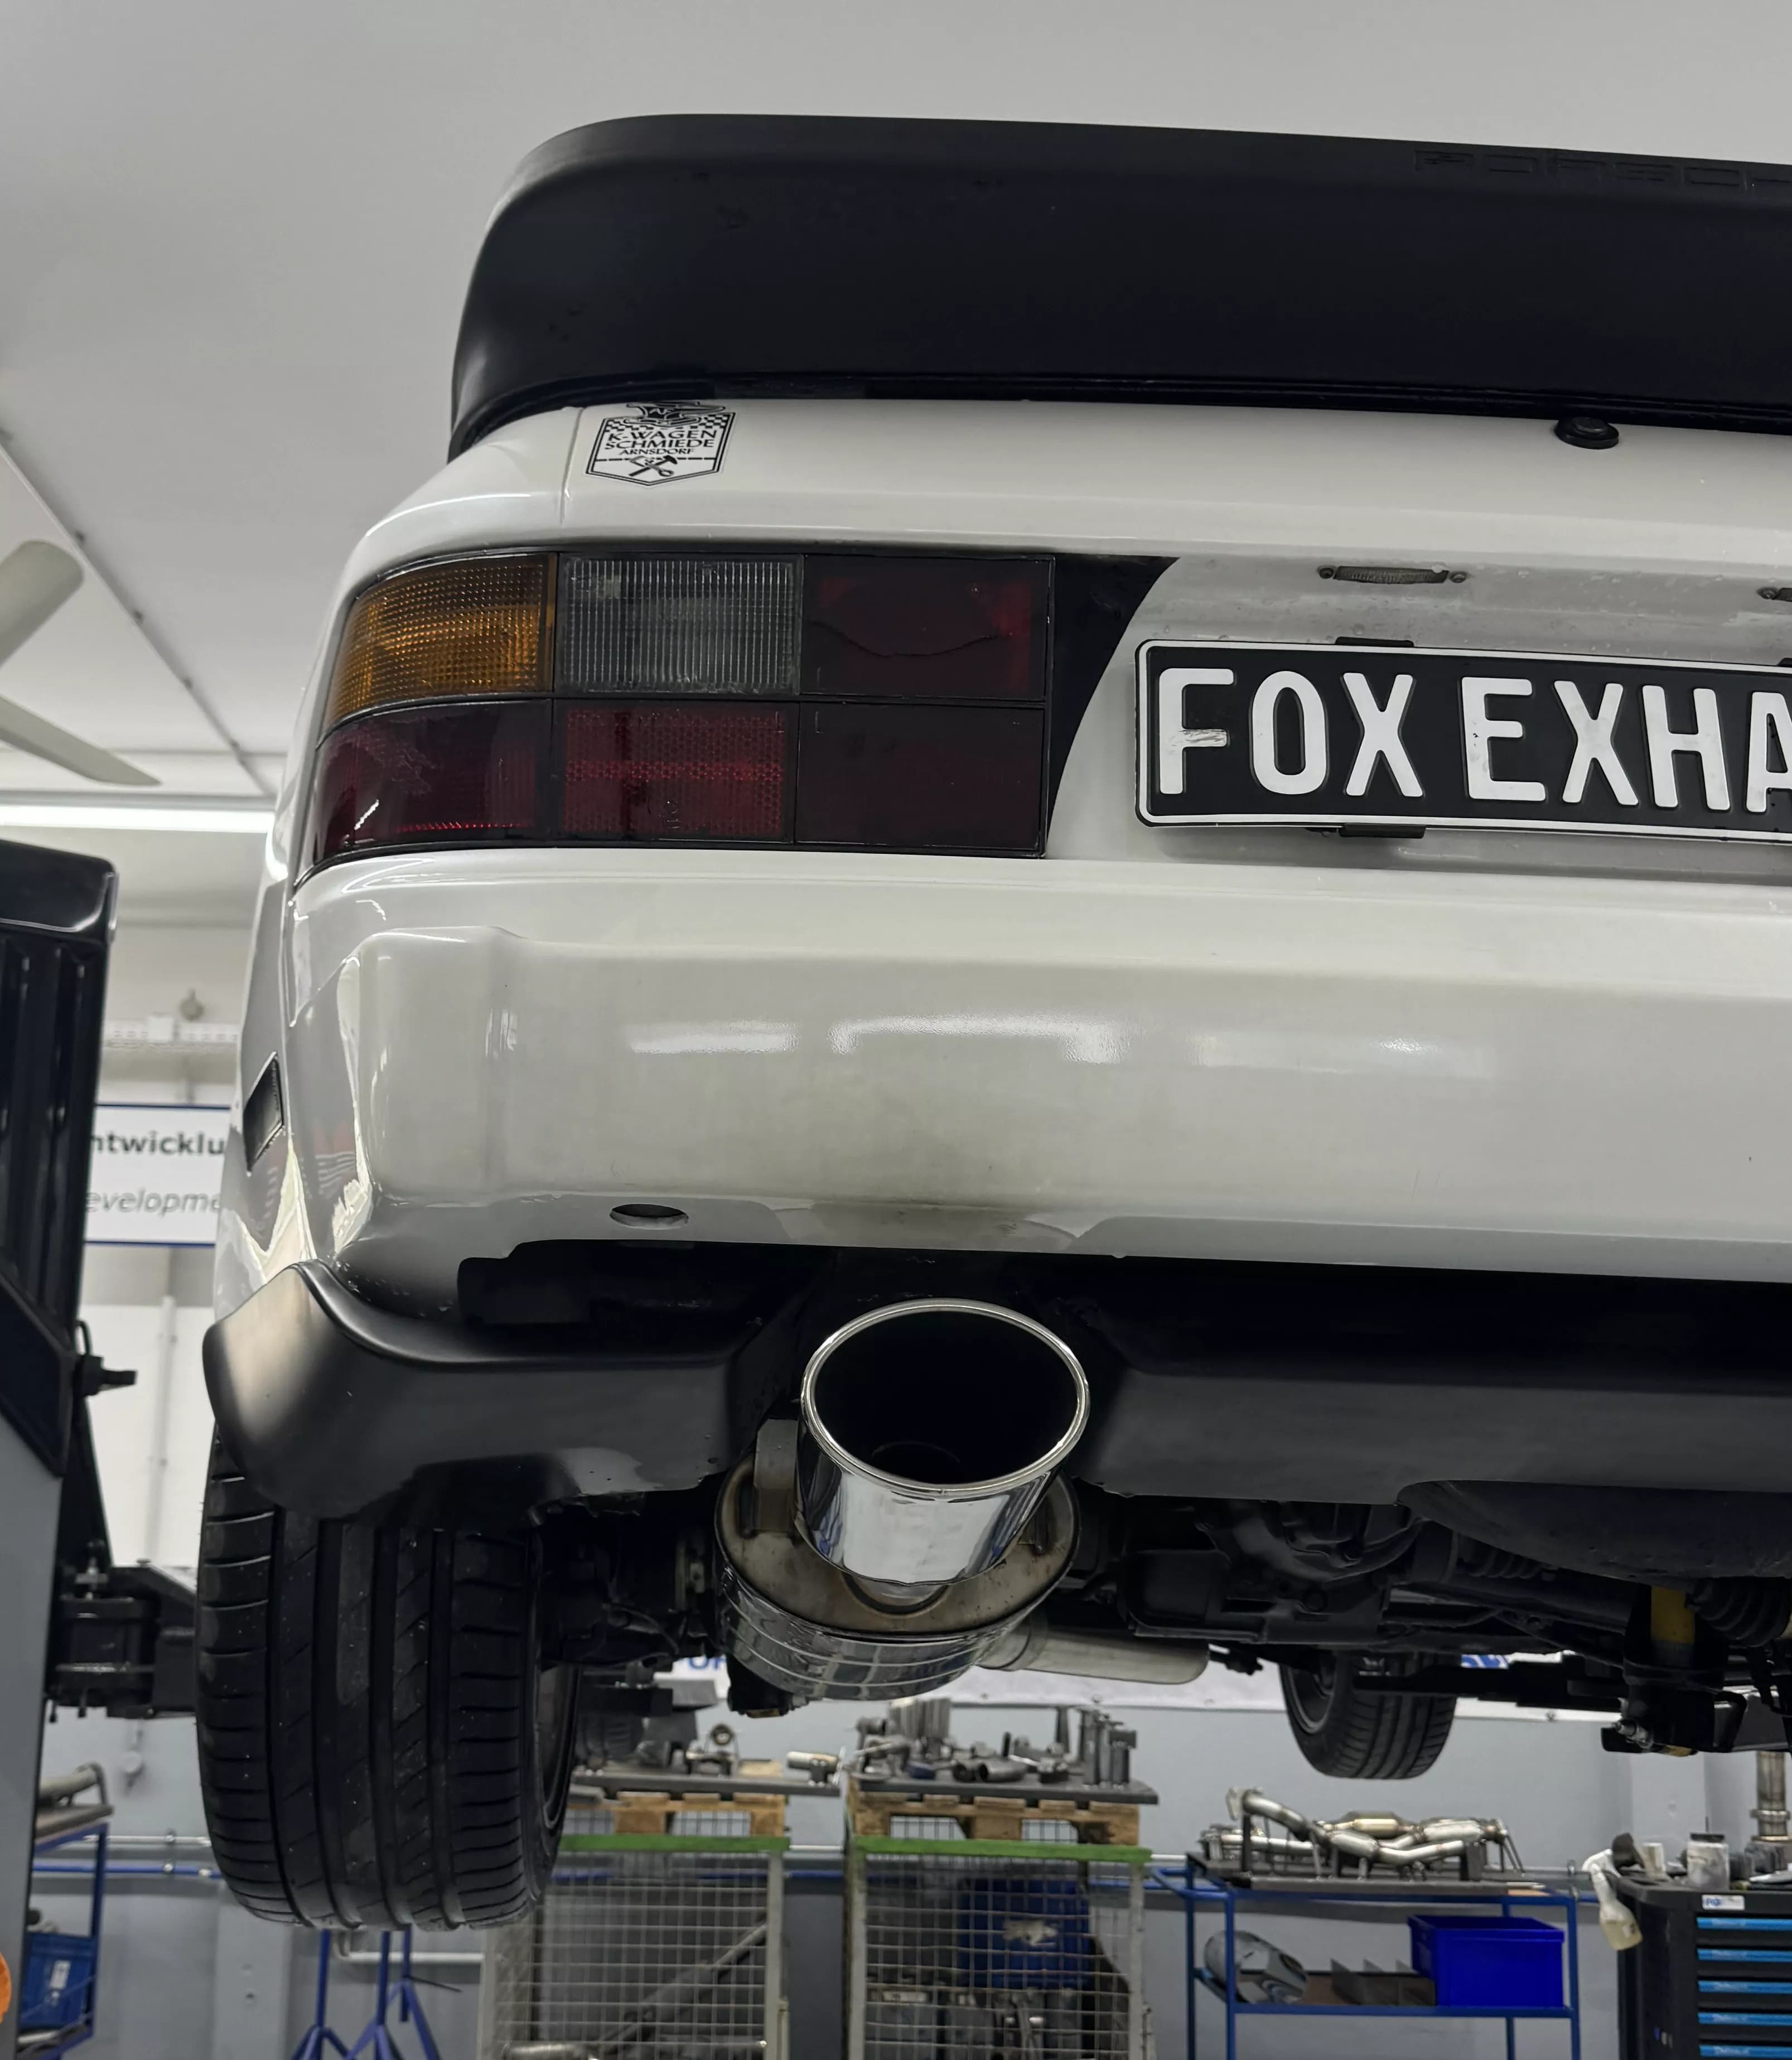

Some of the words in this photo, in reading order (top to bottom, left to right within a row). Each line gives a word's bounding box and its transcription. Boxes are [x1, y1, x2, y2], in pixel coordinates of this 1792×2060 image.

[608, 429, 717, 441] K-WAGEN
[605, 439, 714, 449] SCHMIEDE
[1158, 668, 1423, 797] FOX
[1461, 676, 1792, 813] EXHA
